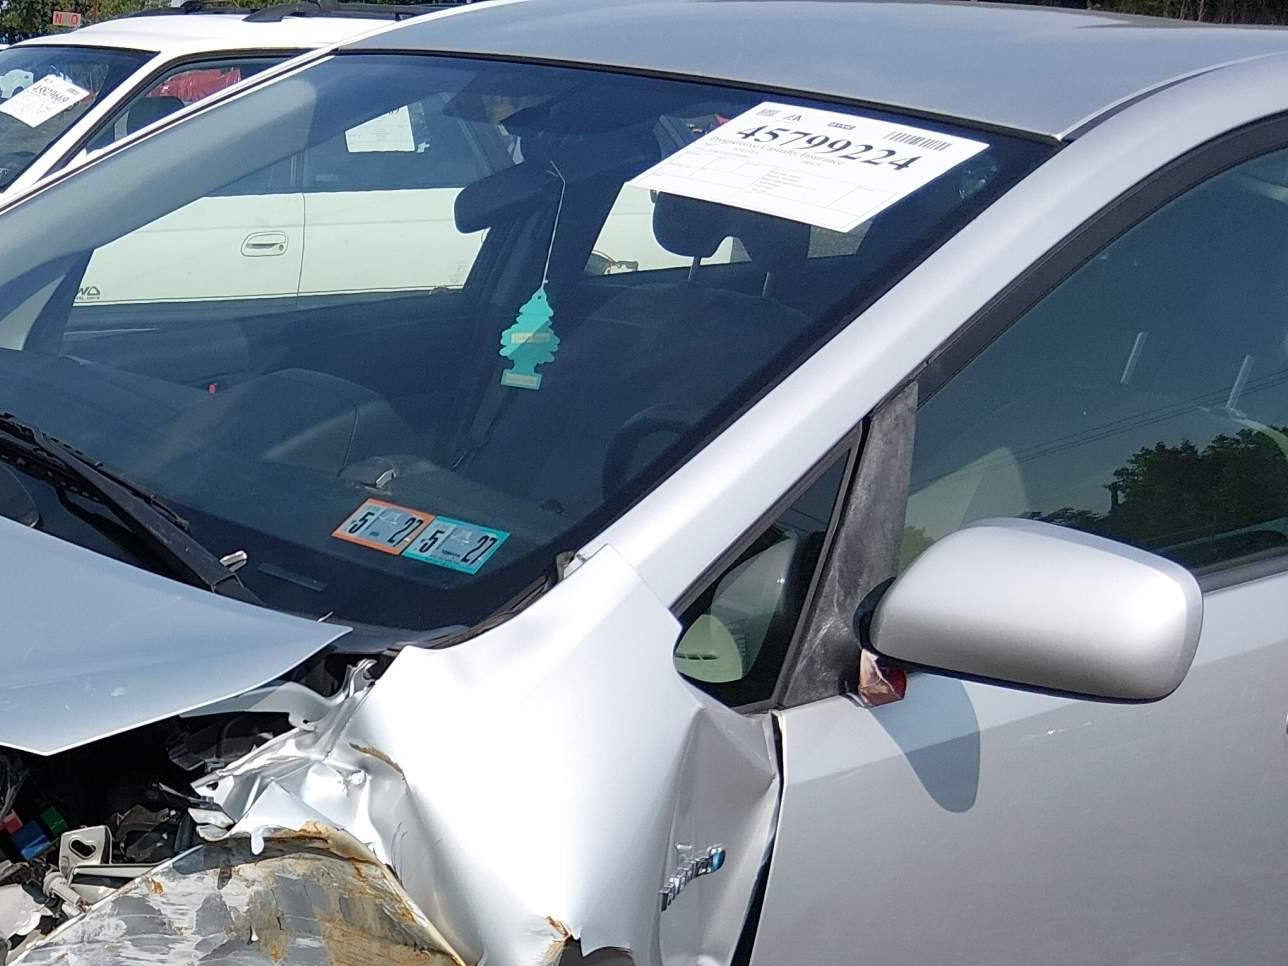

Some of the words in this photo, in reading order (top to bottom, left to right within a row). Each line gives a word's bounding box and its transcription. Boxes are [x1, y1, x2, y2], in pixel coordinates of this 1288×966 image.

[736, 123, 922, 171] 45799224
[348, 511, 375, 534] 5
[387, 516, 424, 547] 27
[418, 529, 445, 553] 5
[460, 534, 498, 564] 27
